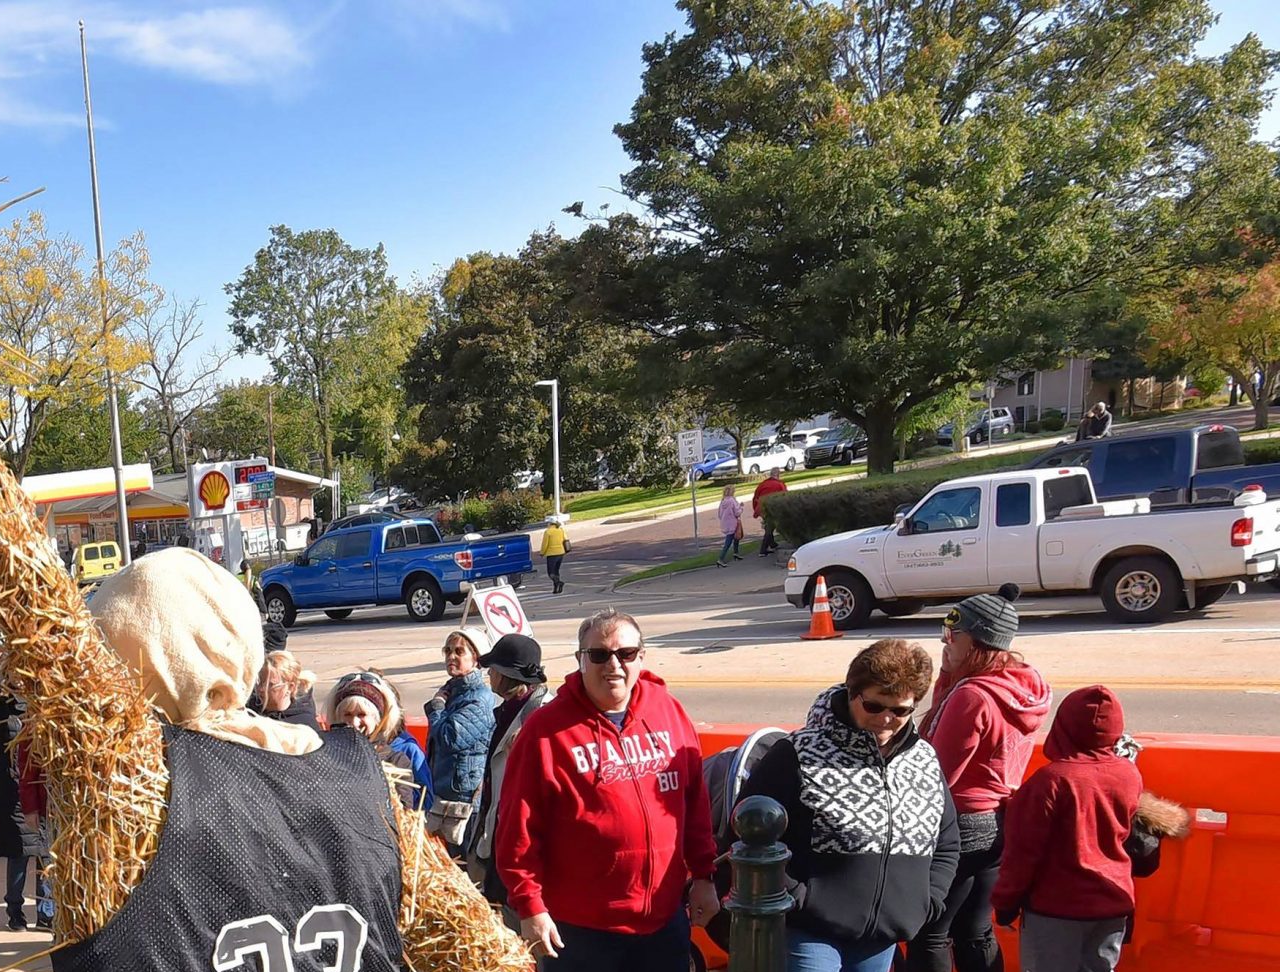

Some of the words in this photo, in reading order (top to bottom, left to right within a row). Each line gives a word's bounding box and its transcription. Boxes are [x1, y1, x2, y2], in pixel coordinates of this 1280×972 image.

[688, 446, 694, 456] 5
[571, 730, 676, 774] BRADLEY
[657, 771, 679, 792] BU
